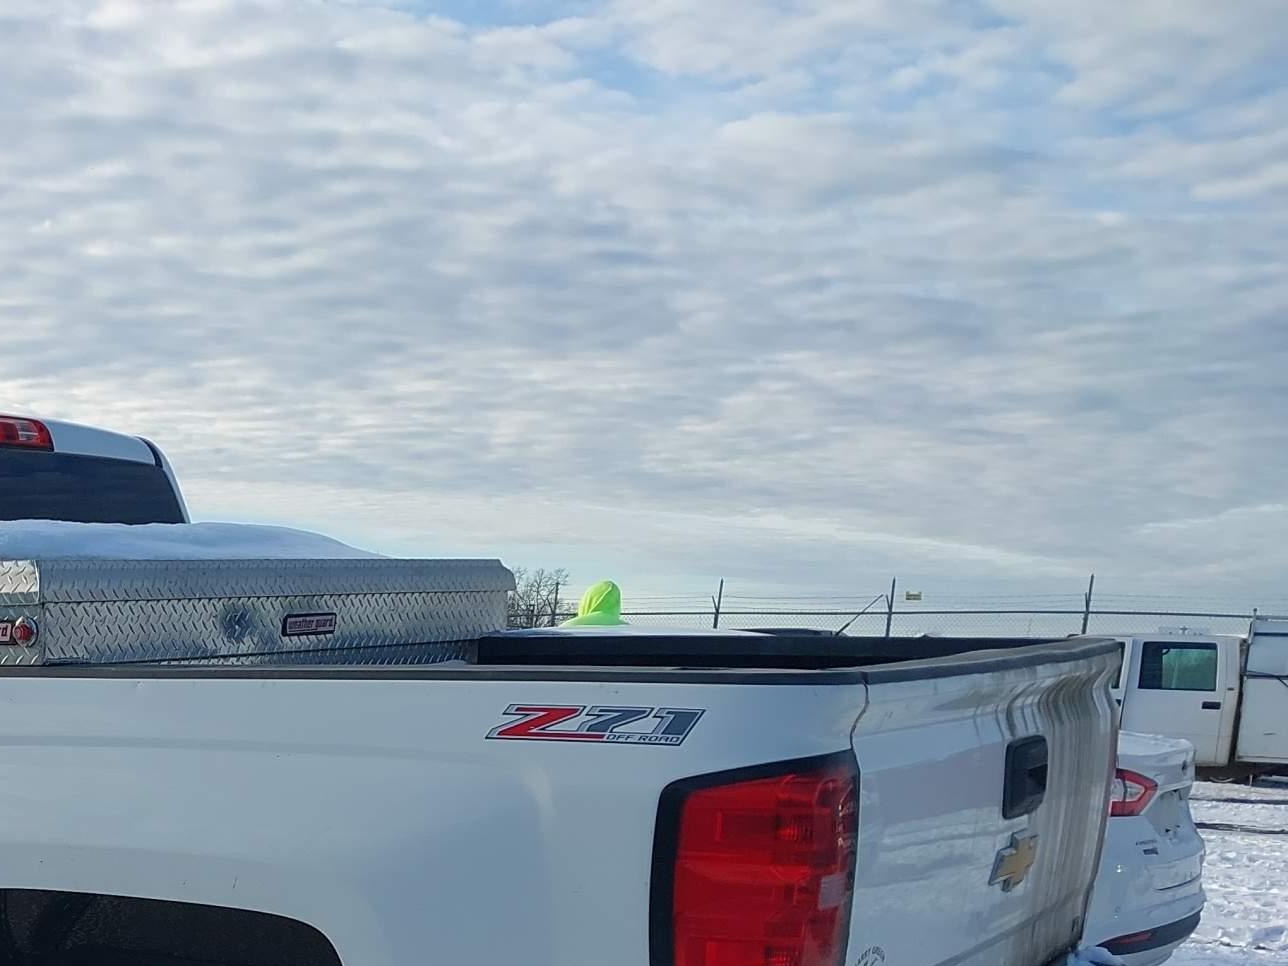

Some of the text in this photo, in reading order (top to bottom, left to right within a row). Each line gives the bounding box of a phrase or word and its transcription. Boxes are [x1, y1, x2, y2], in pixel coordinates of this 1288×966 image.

[485, 704, 707, 746] Z71
[606, 734, 680, 743] OFF ROAD
